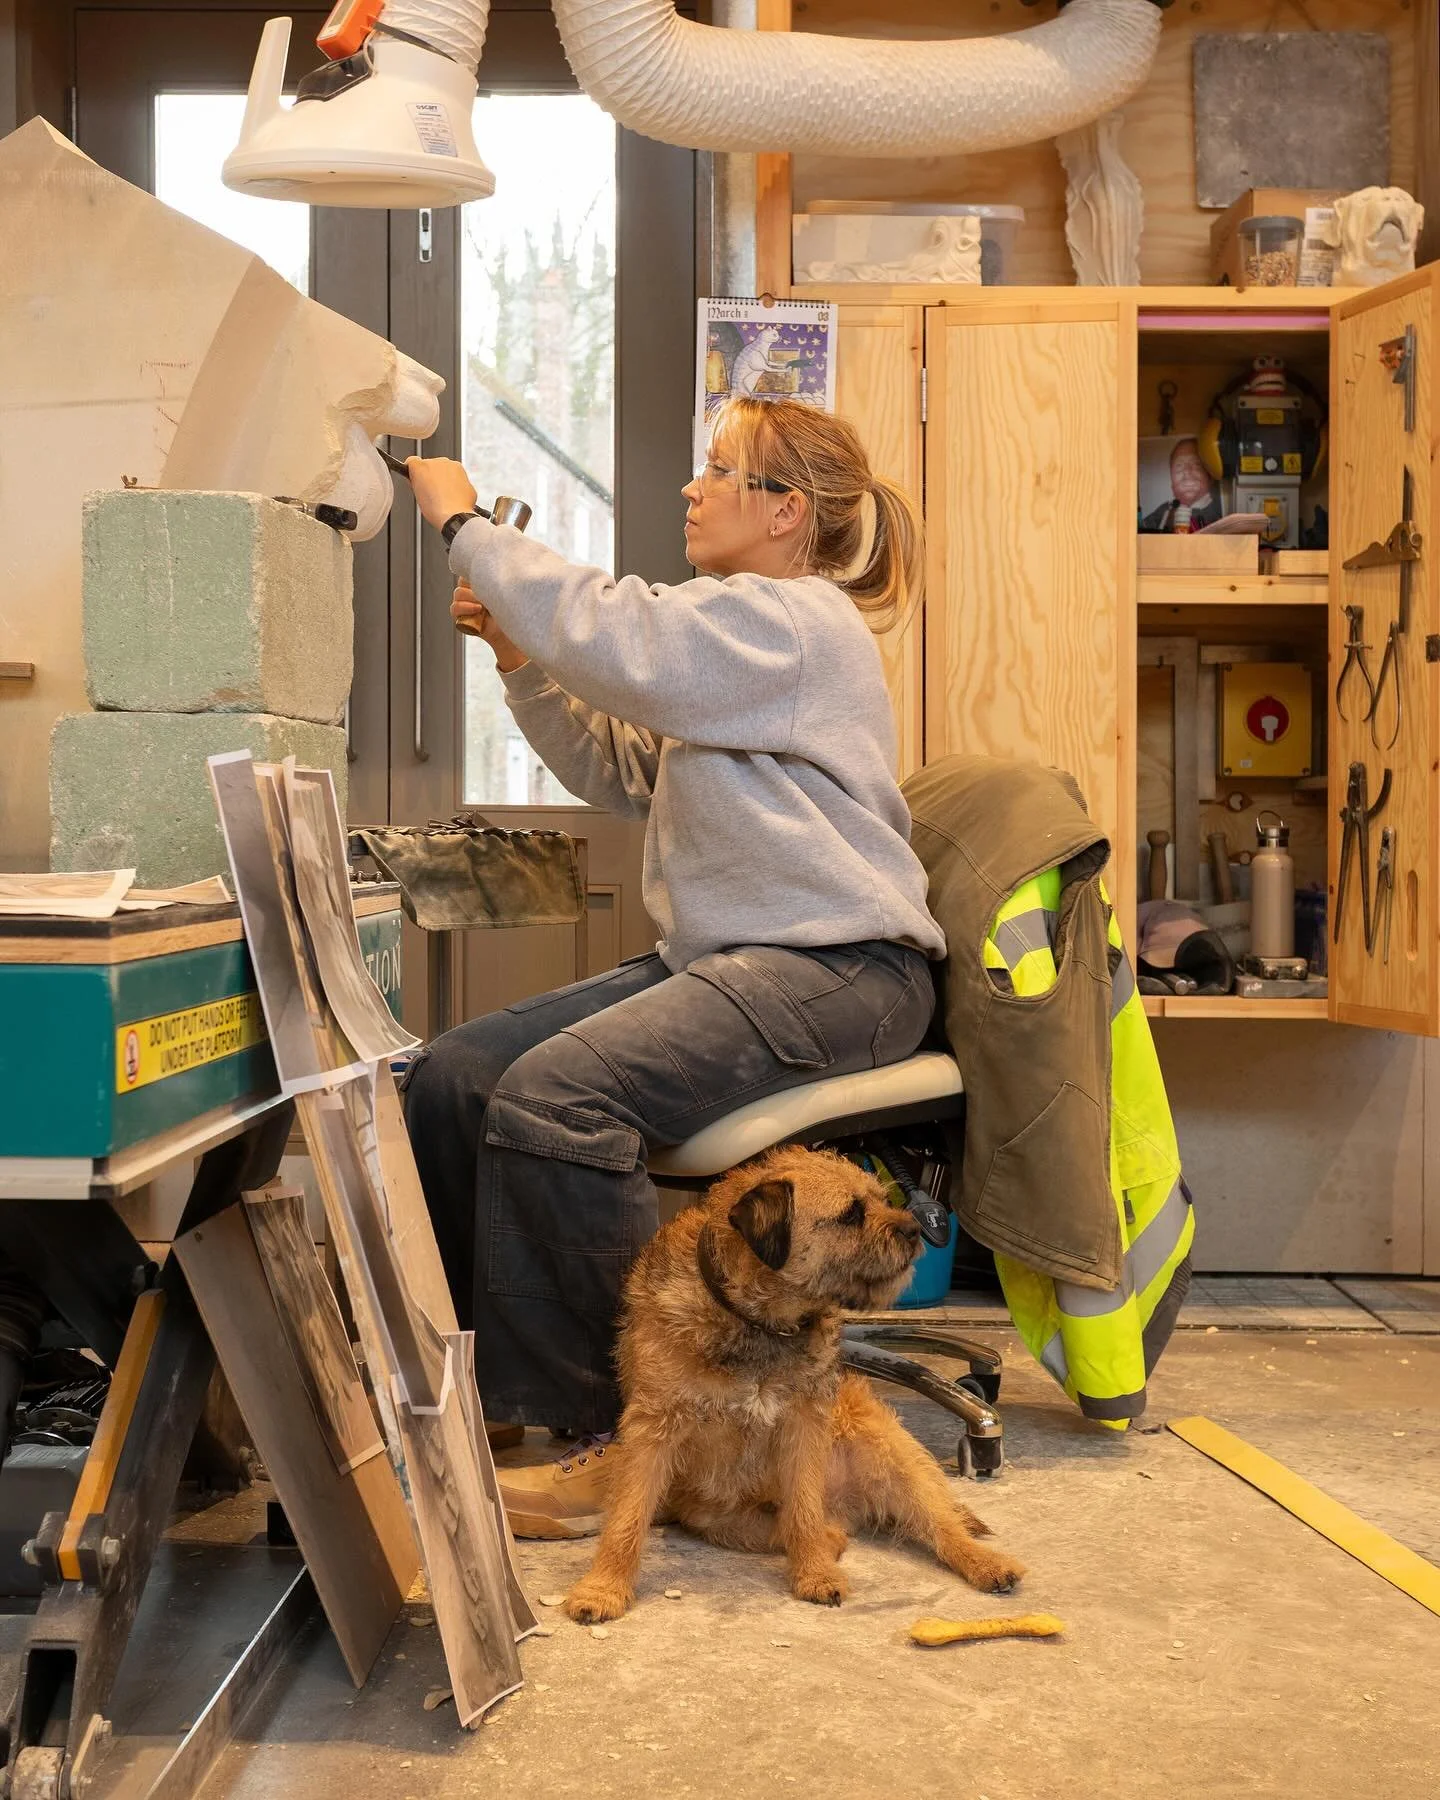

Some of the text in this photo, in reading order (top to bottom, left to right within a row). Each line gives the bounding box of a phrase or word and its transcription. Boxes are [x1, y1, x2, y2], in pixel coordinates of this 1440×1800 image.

[707, 307, 741, 320] March
[150, 1022, 162, 1047] DO
[164, 1016, 181, 1042] NOT
[183, 1013, 197, 1037] PUT
[199, 1005, 224, 1030] HANDS
[225, 1002, 235, 1024] OR
[160, 1027, 242, 1073] UNDER THE PLATFORM
